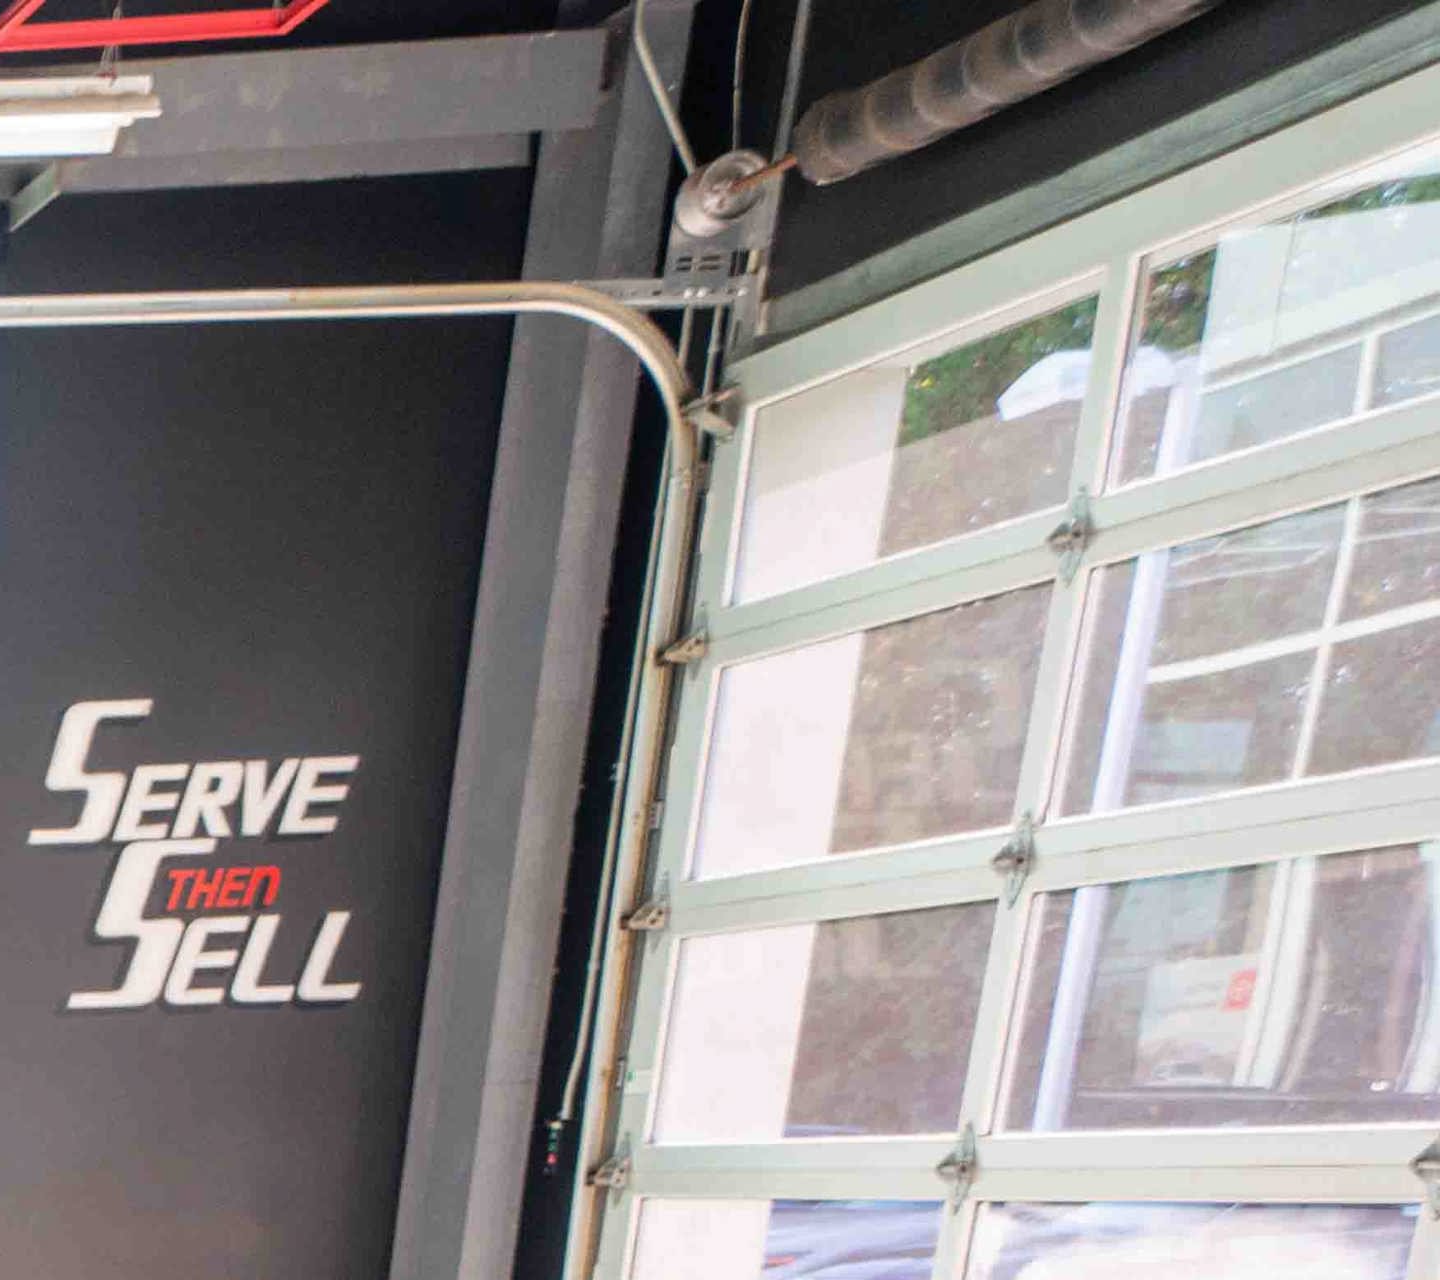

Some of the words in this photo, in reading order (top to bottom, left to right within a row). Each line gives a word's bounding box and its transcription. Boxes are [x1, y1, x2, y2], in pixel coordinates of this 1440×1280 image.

[27, 699, 360, 845] SERVE
[66, 837, 362, 1009] SELL
[166, 866, 281, 910] THEN
